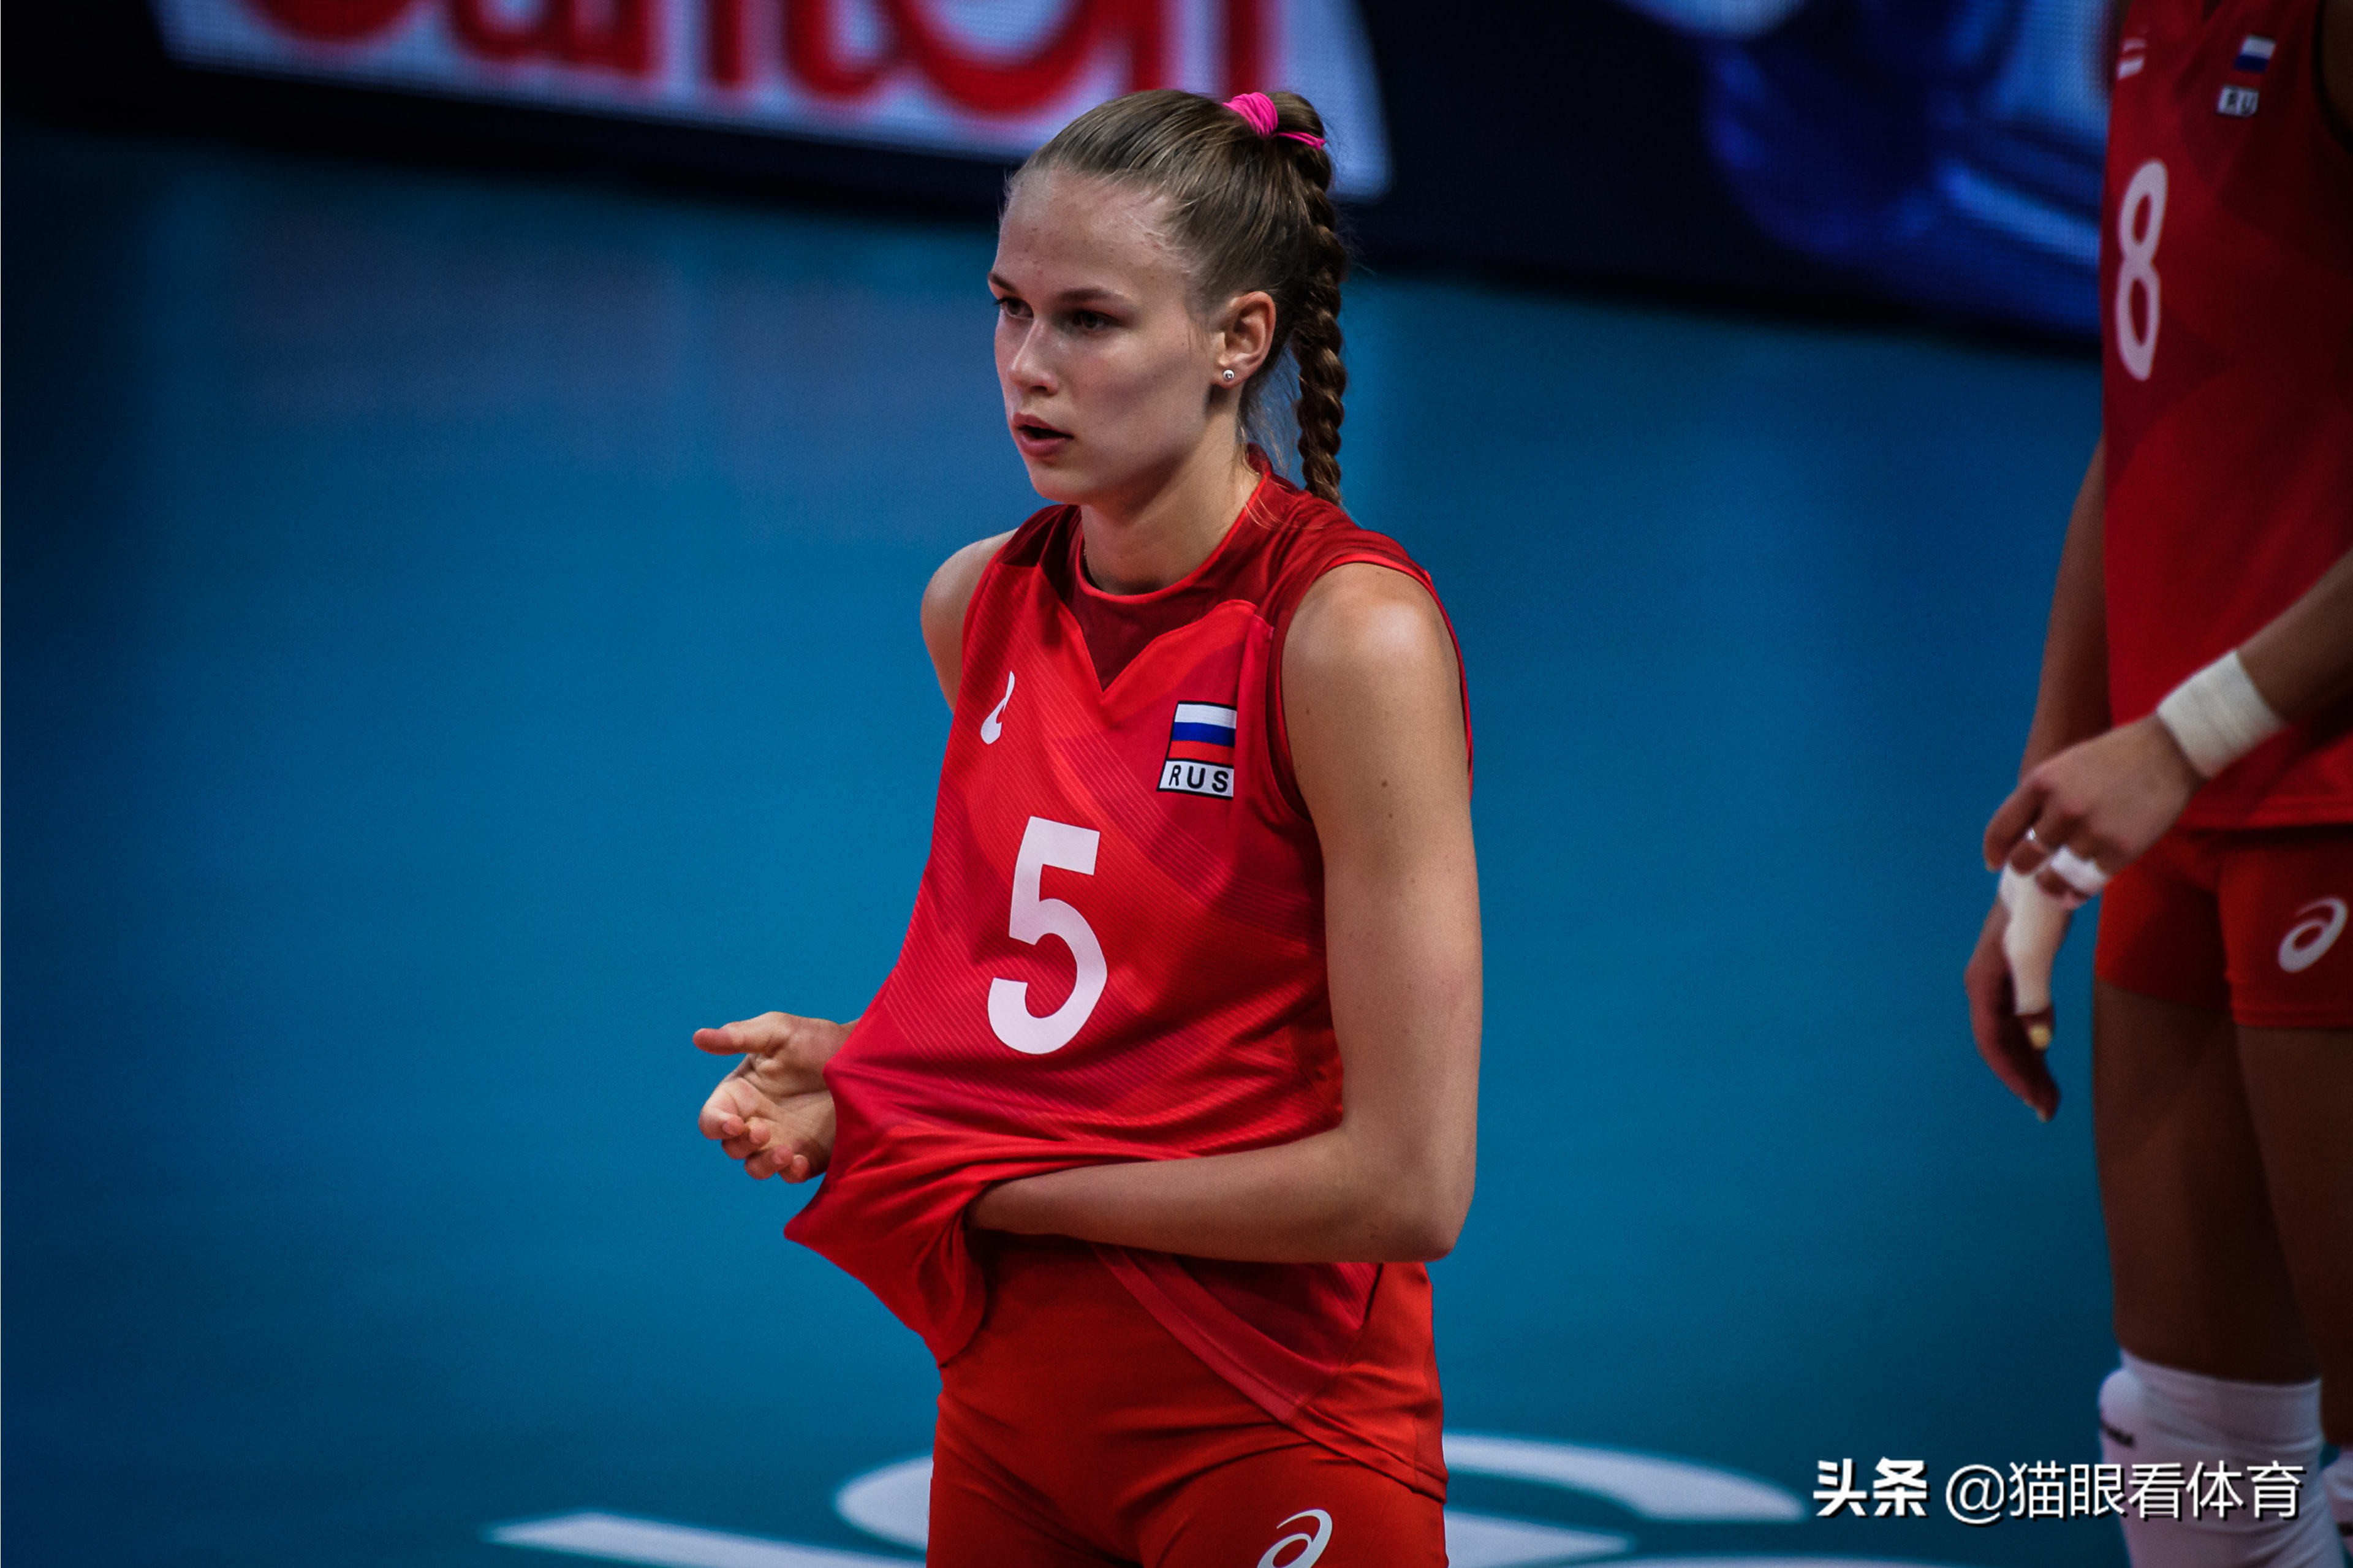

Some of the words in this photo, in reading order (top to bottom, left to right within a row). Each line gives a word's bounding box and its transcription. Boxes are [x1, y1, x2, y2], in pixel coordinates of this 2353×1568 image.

[2117, 161, 2167, 379] 8
[1169, 765, 1229, 793] RUS
[988, 816, 1107, 1055] 5
